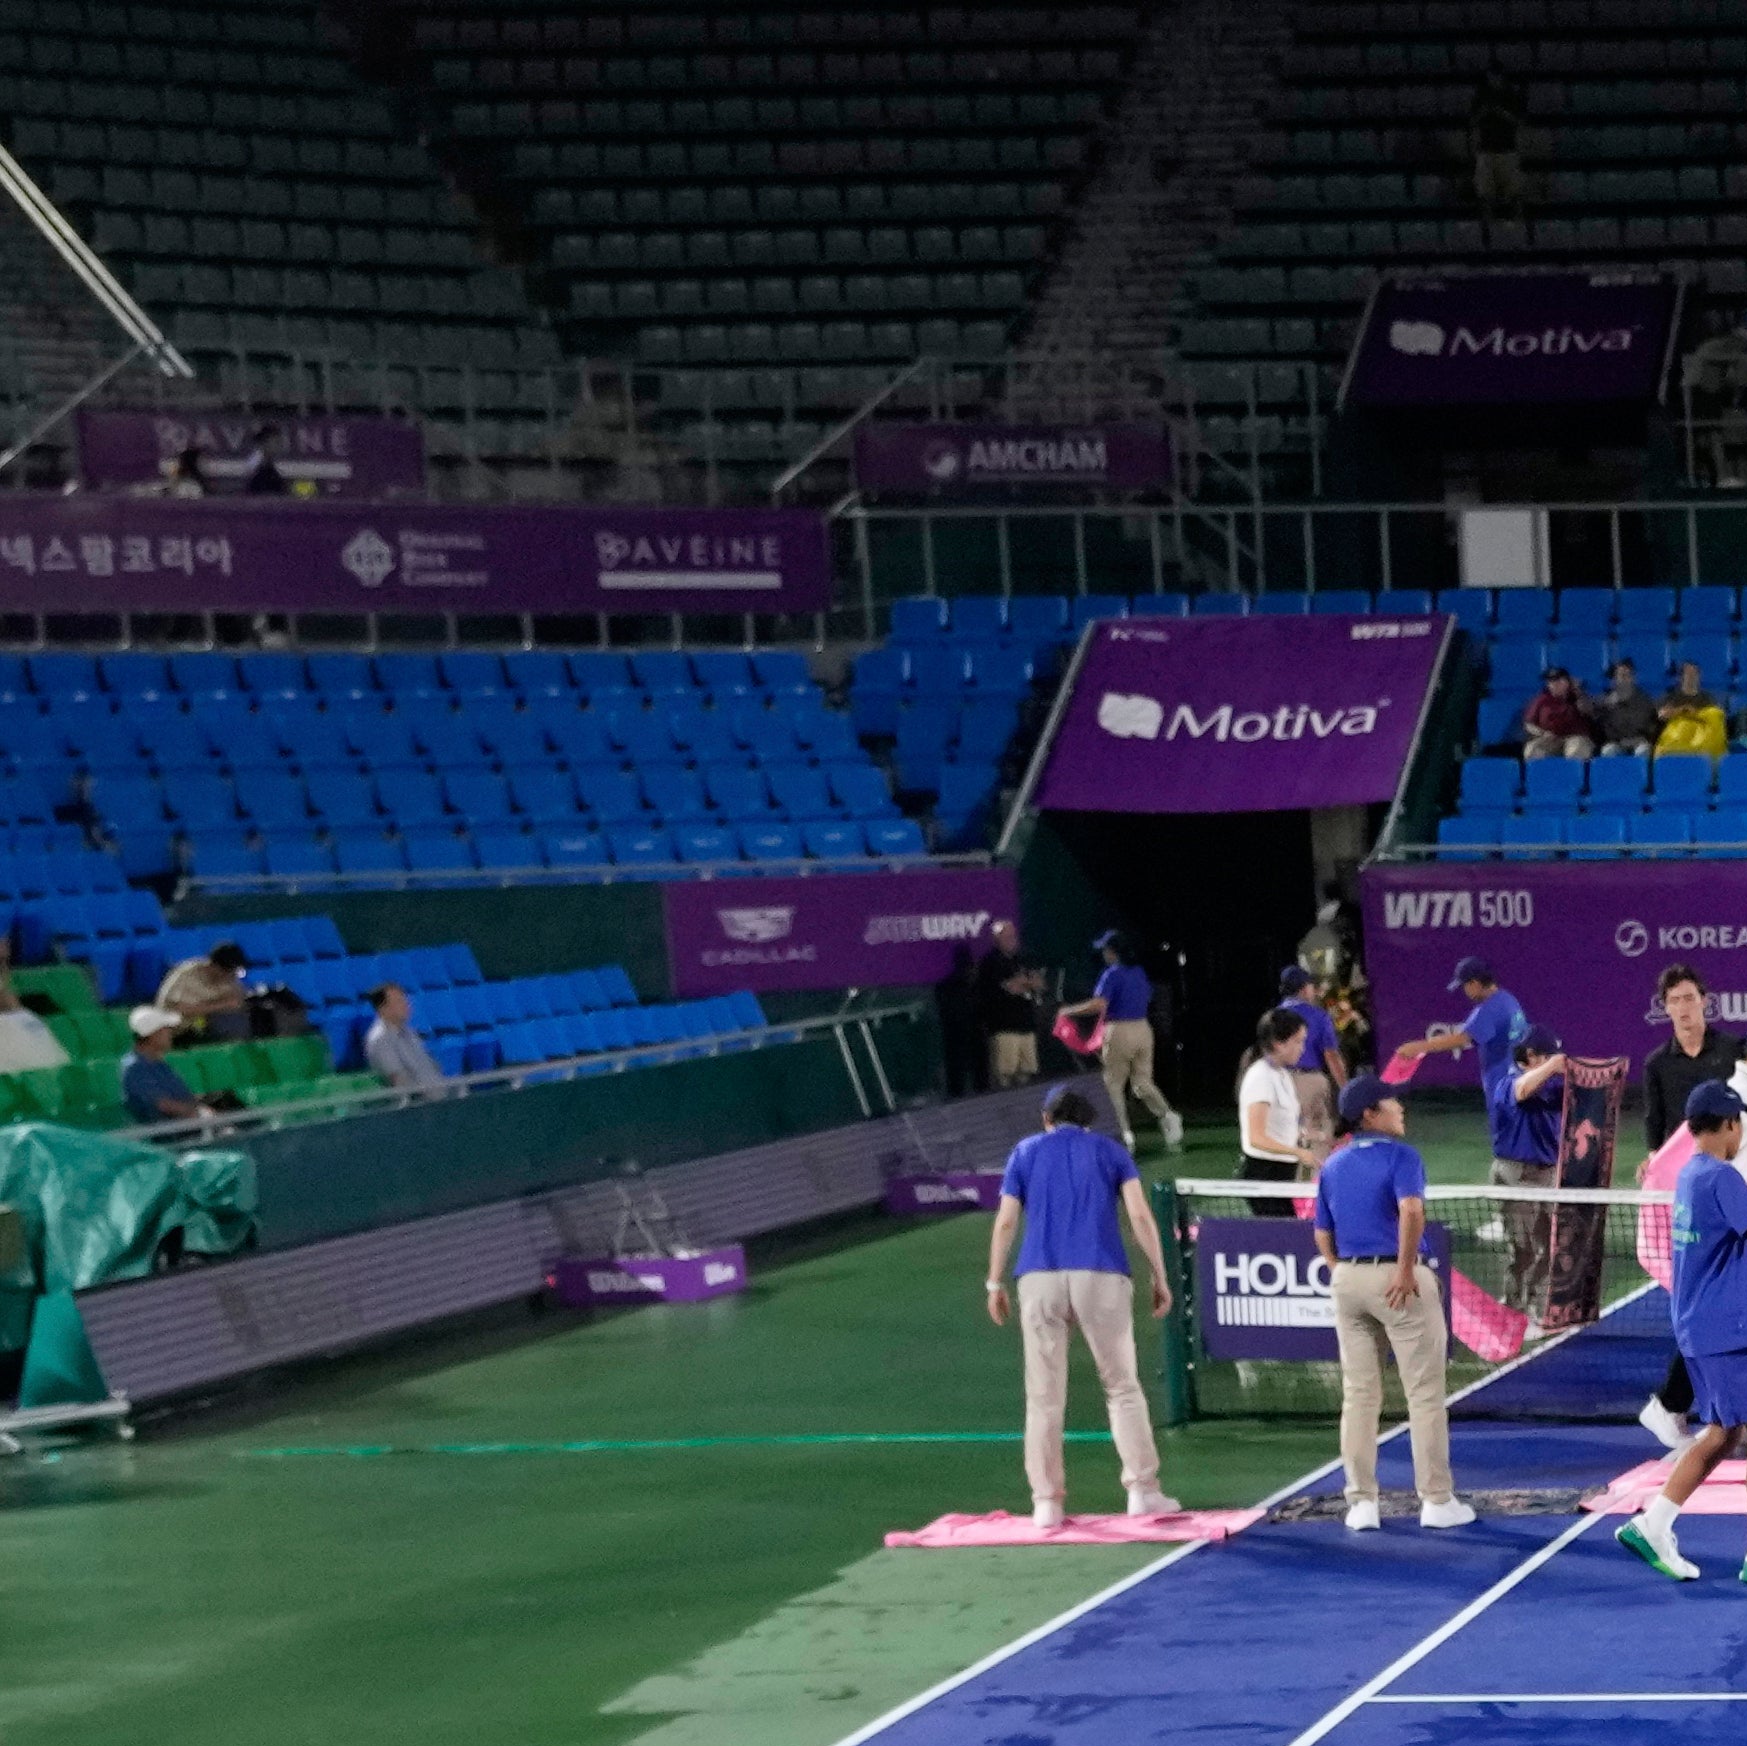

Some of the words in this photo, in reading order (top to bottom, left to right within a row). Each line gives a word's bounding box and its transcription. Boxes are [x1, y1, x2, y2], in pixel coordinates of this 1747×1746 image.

[1449, 326, 1634, 357] Motiva
[968, 440, 1107, 469] AMCHAM
[1165, 699, 1378, 743] Motiva
[1384, 891, 1474, 929] WTA
[1478, 890, 1534, 928] 500
[1214, 1252, 1336, 1297] HOLO
